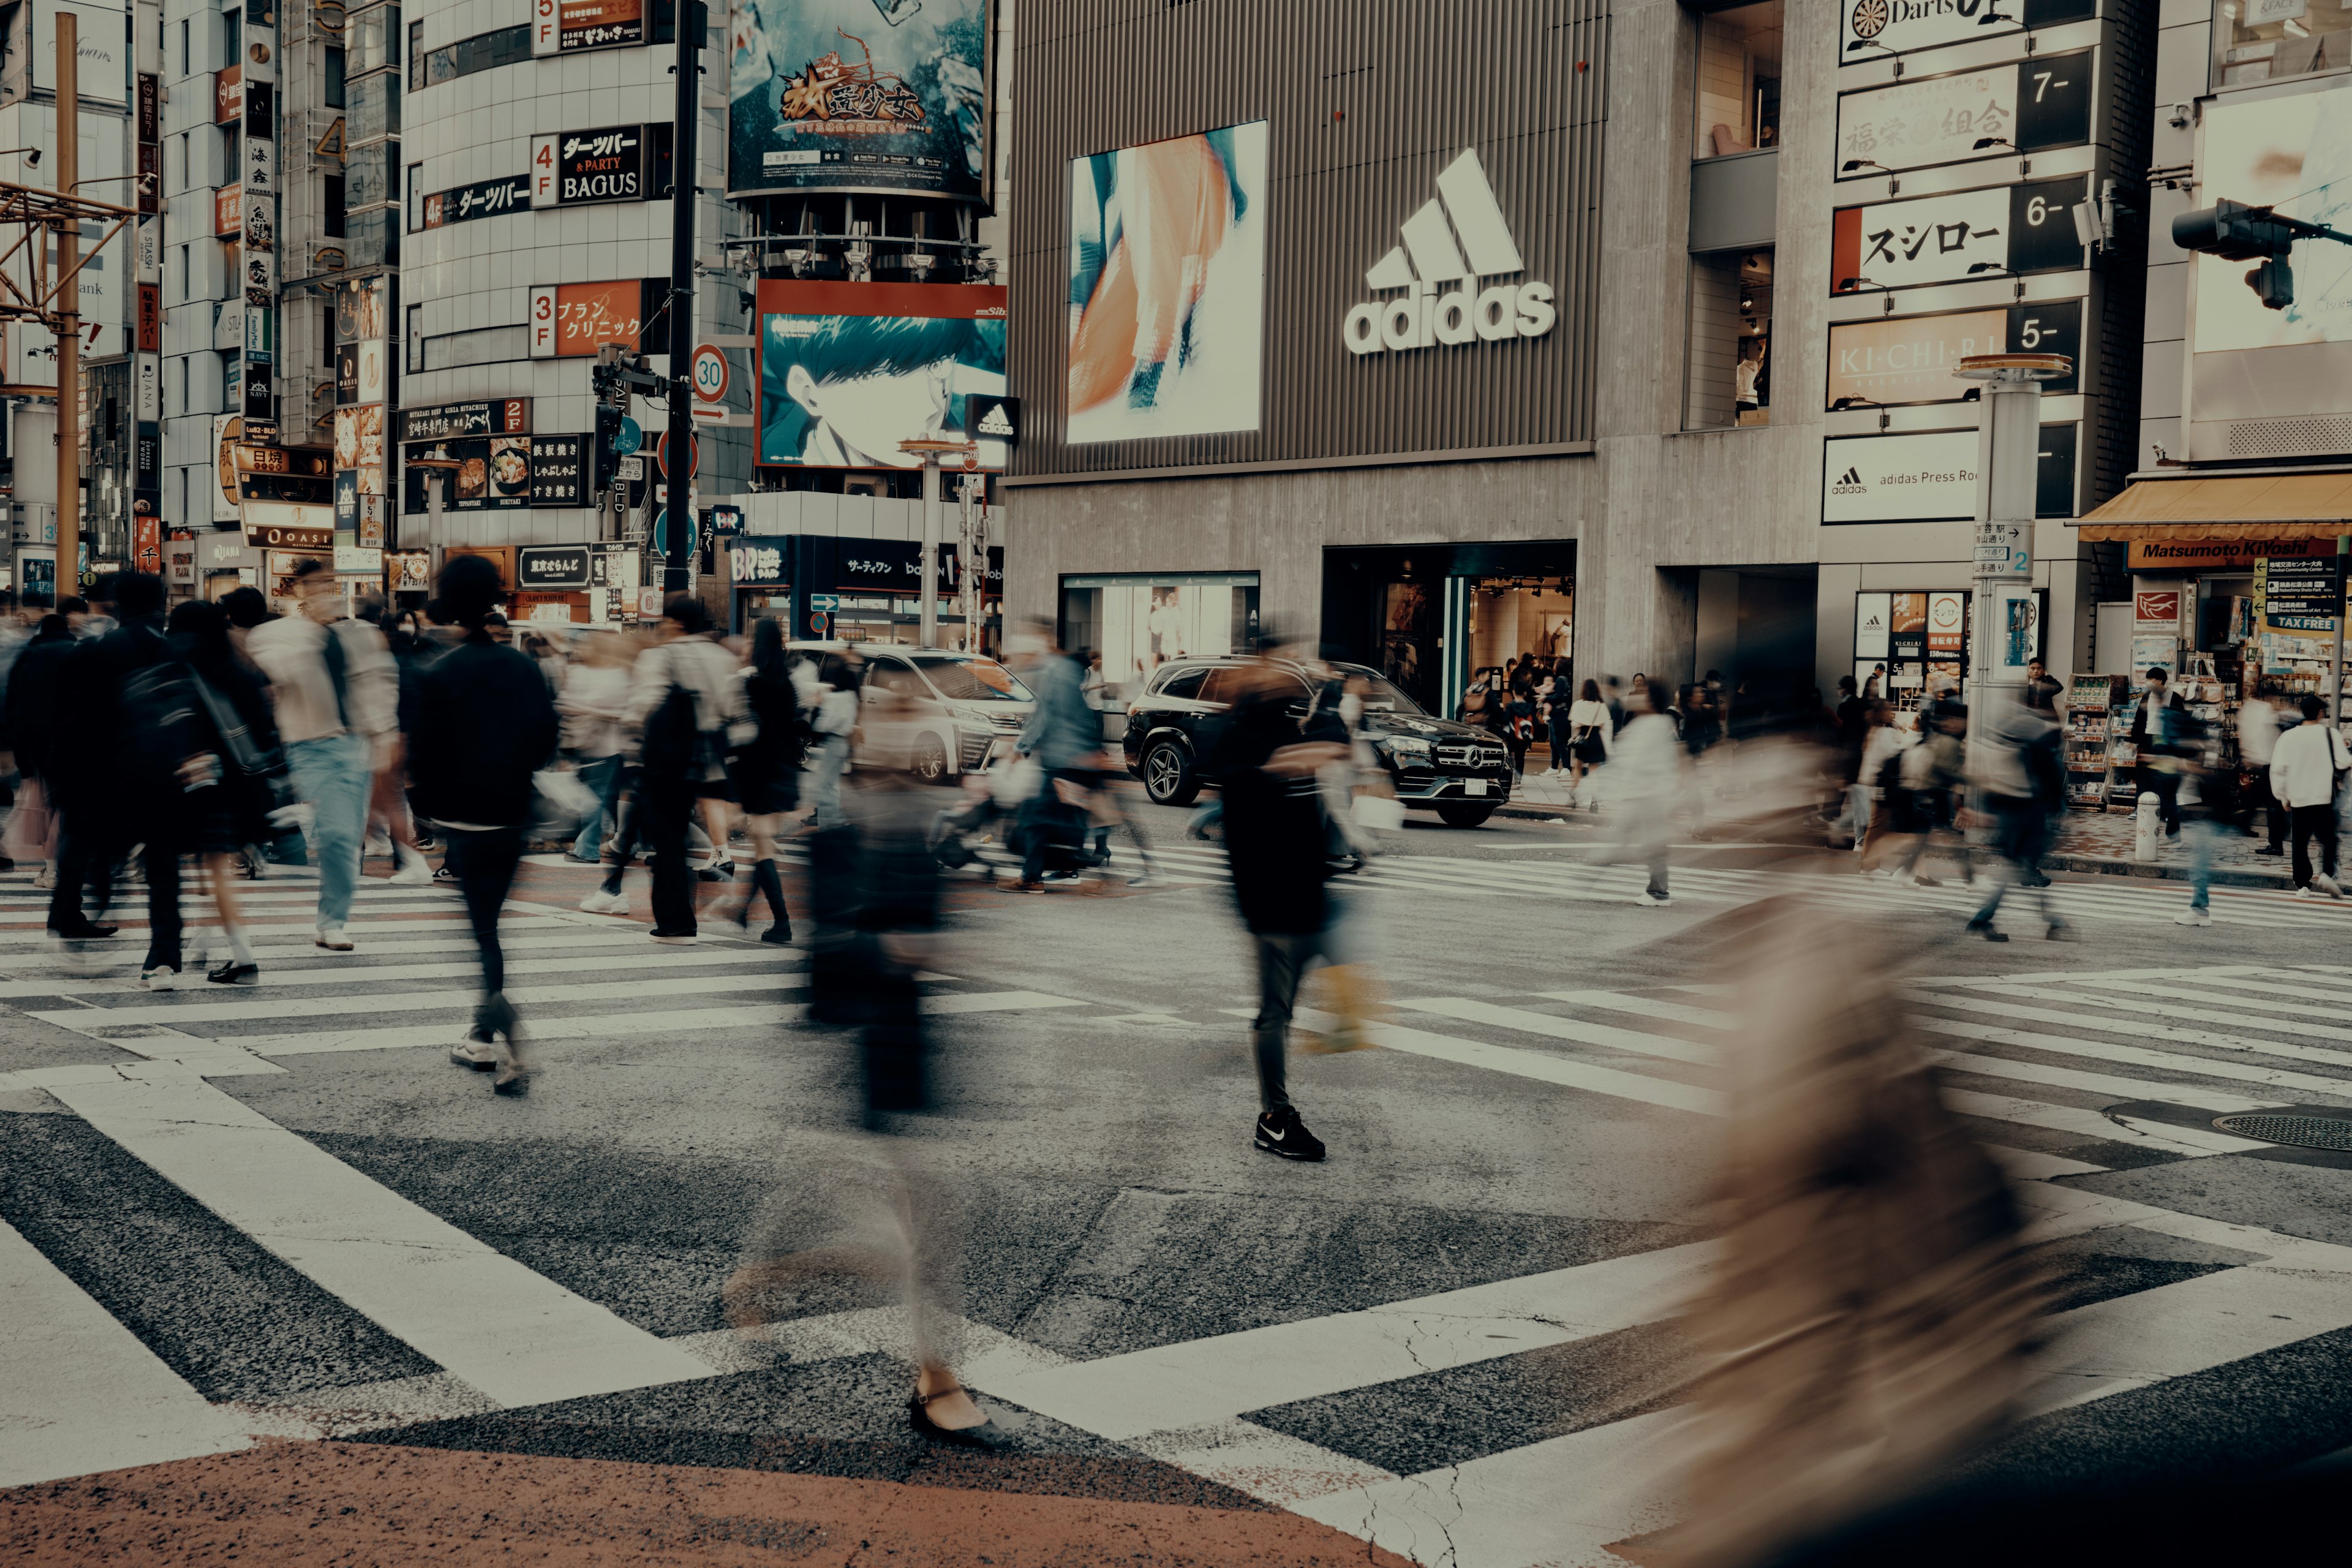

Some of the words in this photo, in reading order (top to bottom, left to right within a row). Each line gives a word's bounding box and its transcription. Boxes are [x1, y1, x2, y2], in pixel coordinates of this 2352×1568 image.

[1939, 98, 2010, 140] 組合
[564, 133, 637, 160] ダーツバー
[585, 157, 621, 172] PARTY
[564, 172, 637, 199] BAGUS
[459, 181, 529, 217] ダーツバー
[426, 198, 442, 224] 4F
[1862, 221, 2001, 267] スシロー
[141, 290, 154, 345] 駄菓子バー
[558, 301, 605, 320] ブラン
[1343, 273, 1556, 355] adidas
[566, 318, 640, 339] クリニック
[339, 378, 358, 386] OASIS
[698, 360, 720, 386] 30
[460, 403, 489, 412] MIYACHIKU
[408, 417, 449, 437] 宮崎牛専門店
[978, 421, 1014, 435] adidas
[533, 443, 577, 457] 鉄板焼き
[534, 464, 577, 477] しゃぶしゃぶ
[1879, 472, 1918, 485] adidas
[1921, 471, 1956, 483] Press
[533, 485, 576, 497] すき焼き
[615, 482, 626, 513] BLD
[1831, 483, 1868, 495] adidas
[339, 505, 354, 514] NAVY
[715, 511, 739, 529] BR
[44, 526, 55, 540] 3
[139, 545, 159, 566] 千
[2143, 544, 2241, 558] Matsumoto
[2242, 540, 2309, 556] KiYoshi
[729, 547, 758, 581] BR
[848, 560, 892, 574] サーティワン
[2014, 551, 2028, 571] 2
[1932, 608, 1961, 617] スシロー
[2278, 617, 2301, 628] TAX
[2303, 619, 2332, 630] FREE
[1930, 636, 1960, 646] 回転寿司
